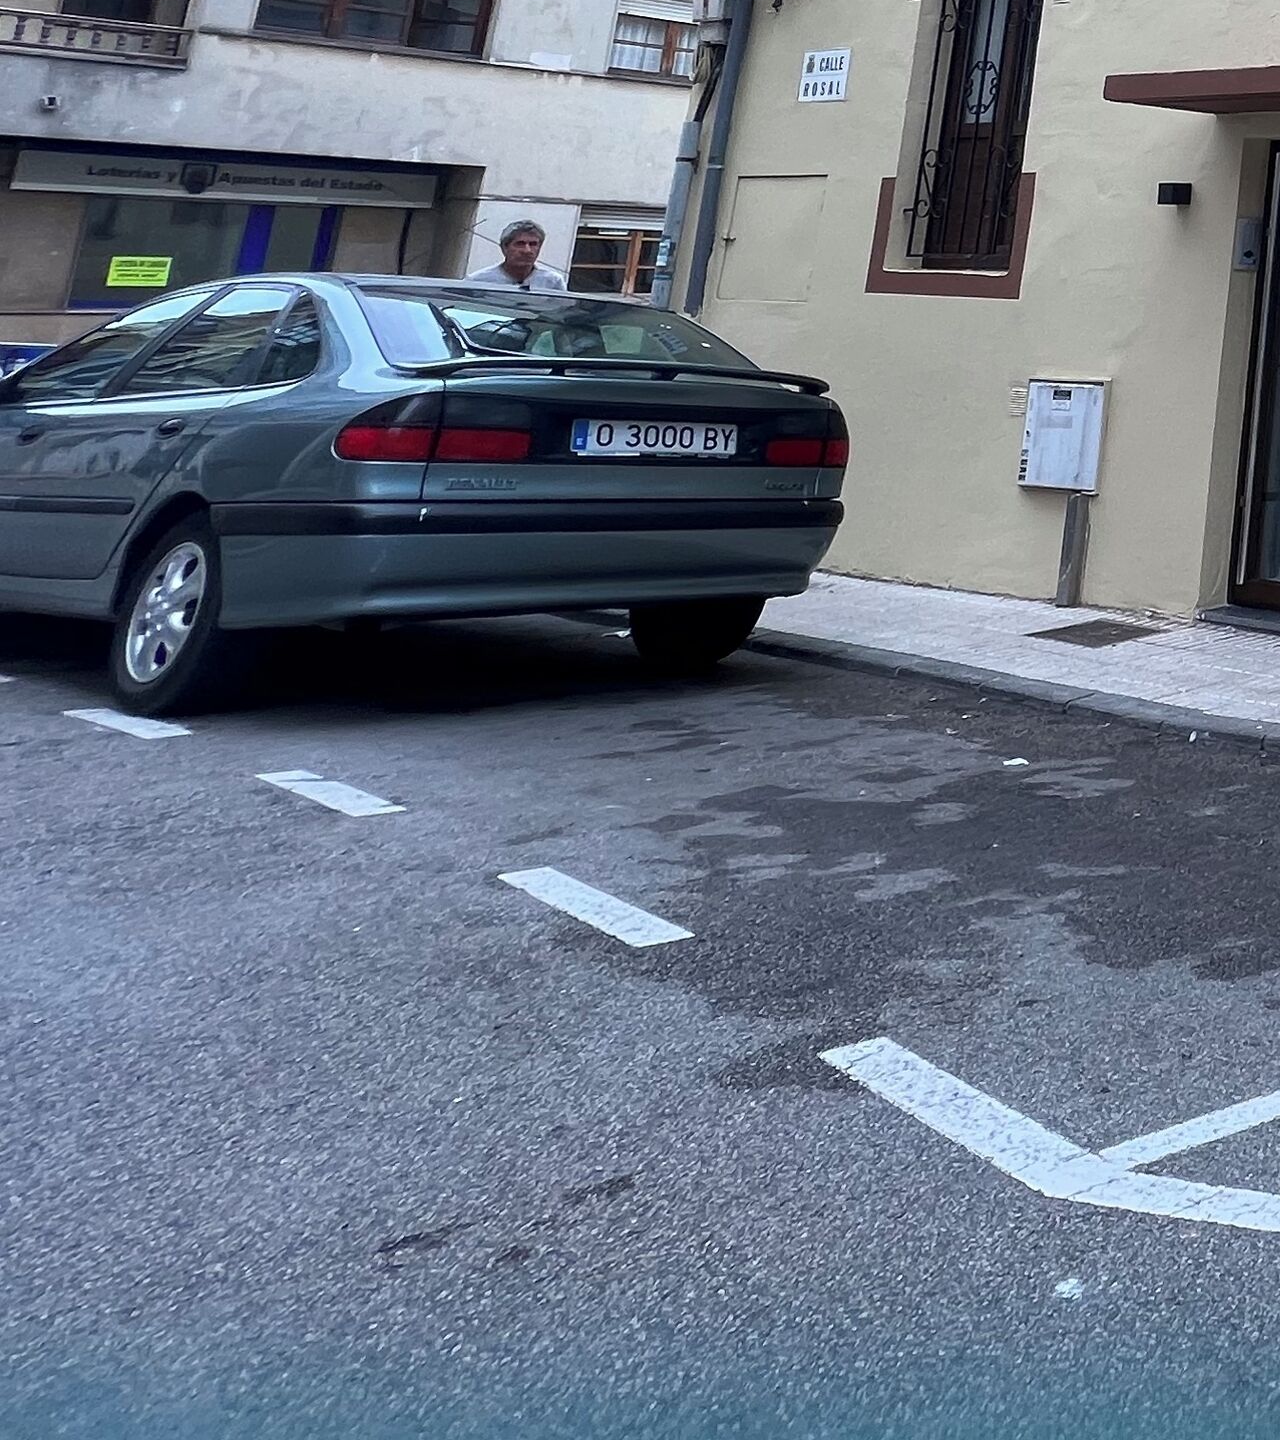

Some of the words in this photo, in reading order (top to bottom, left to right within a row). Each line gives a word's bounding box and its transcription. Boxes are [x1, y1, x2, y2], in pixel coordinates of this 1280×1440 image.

[819, 56, 845, 72] CALLE
[803, 81, 841, 97] ROSAL
[166, 171, 177, 183] y
[217, 171, 296, 187] Apuestas
[300, 177, 325, 189] del
[330, 178, 383, 191] Estado
[625, 424, 695, 449] 3000
[703, 427, 734, 451] BY
